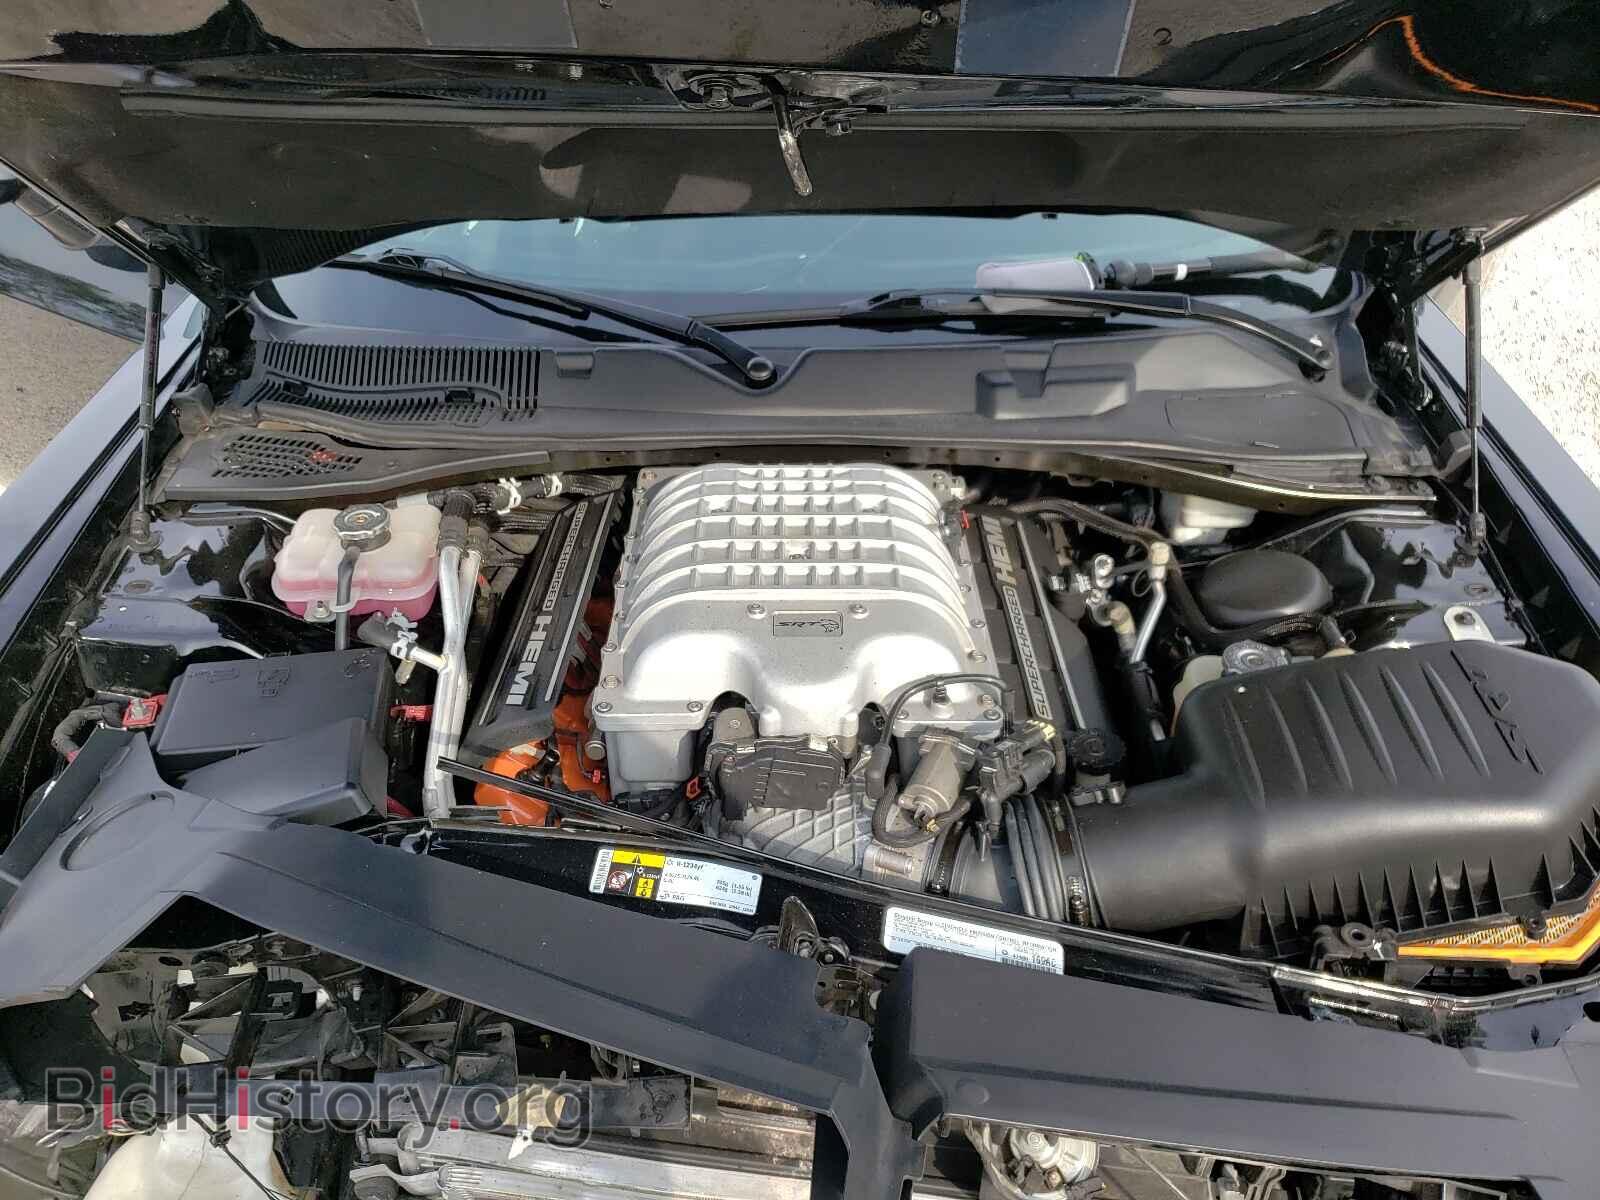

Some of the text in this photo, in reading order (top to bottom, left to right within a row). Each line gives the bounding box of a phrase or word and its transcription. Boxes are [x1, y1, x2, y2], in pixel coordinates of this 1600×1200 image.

[505, 502, 588, 705] SUPERCHARGED HEMI
[981, 515, 1052, 719] SUPERCHARGED HEMI
